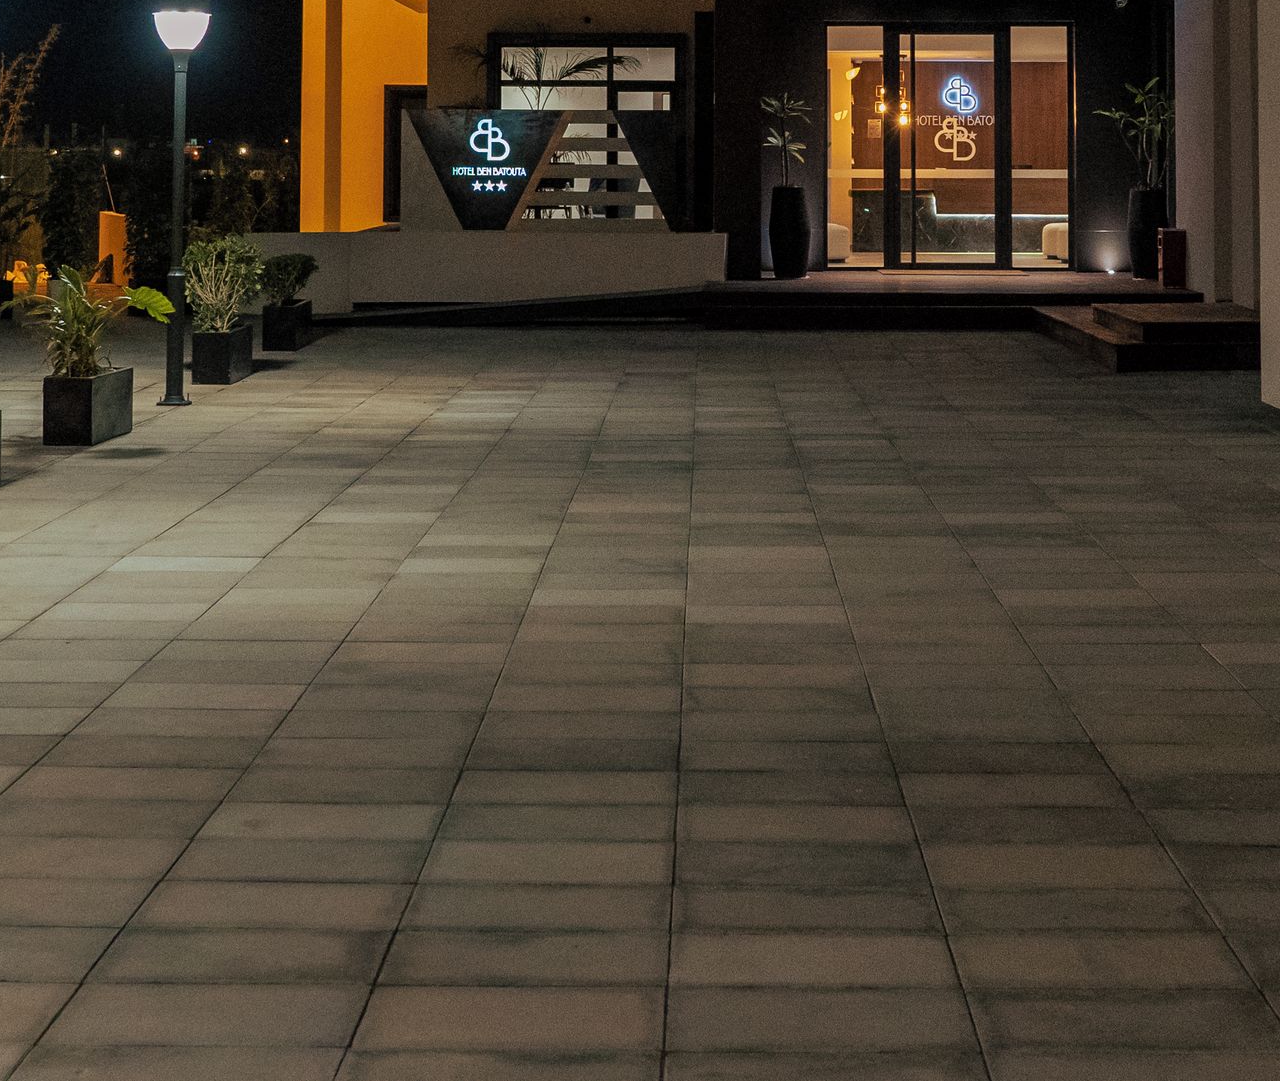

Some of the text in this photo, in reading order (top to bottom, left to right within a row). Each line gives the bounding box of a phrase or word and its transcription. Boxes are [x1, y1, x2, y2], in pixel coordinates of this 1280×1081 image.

[452, 166, 527, 177] HOTEL BEN BATOUTA
